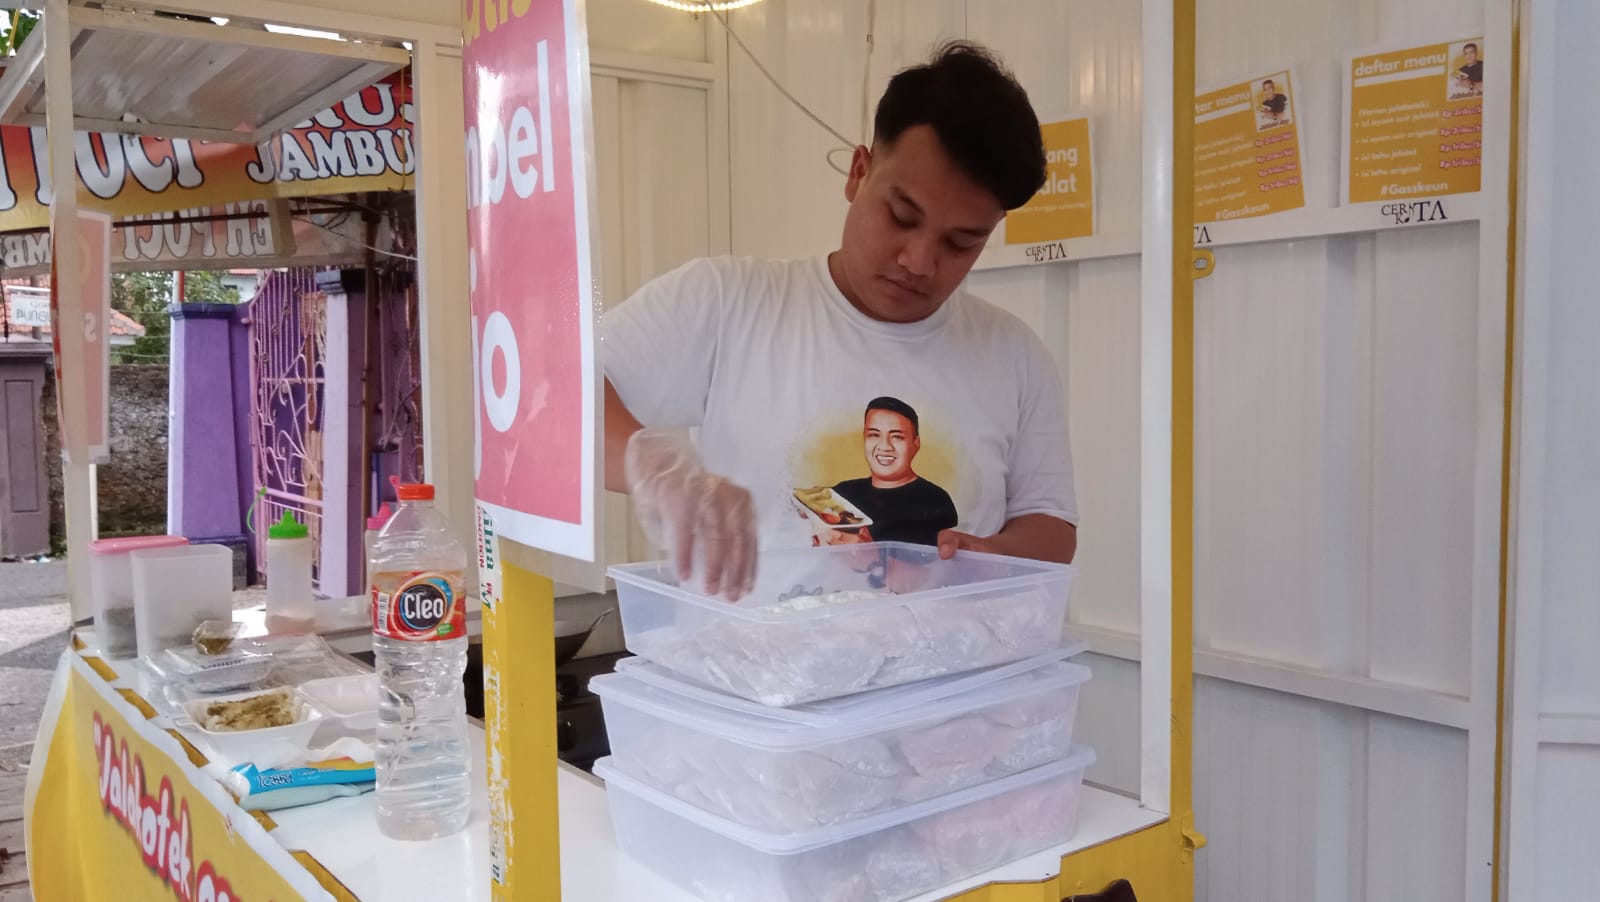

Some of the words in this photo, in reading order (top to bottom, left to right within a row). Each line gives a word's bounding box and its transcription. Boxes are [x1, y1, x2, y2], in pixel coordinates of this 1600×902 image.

[1354, 59, 1400, 77] daftar
[1404, 53, 1446, 68] menu
[1194, 101, 1213, 114] tar
[1216, 91, 1250, 107] menu
[464, 40, 555, 209] mbel
[247, 127, 414, 184] JAMBU
[1040, 171, 1077, 195] alat
[1380, 181, 1448, 196] #Gasskeun
[404, 593, 444, 619] Cleo
